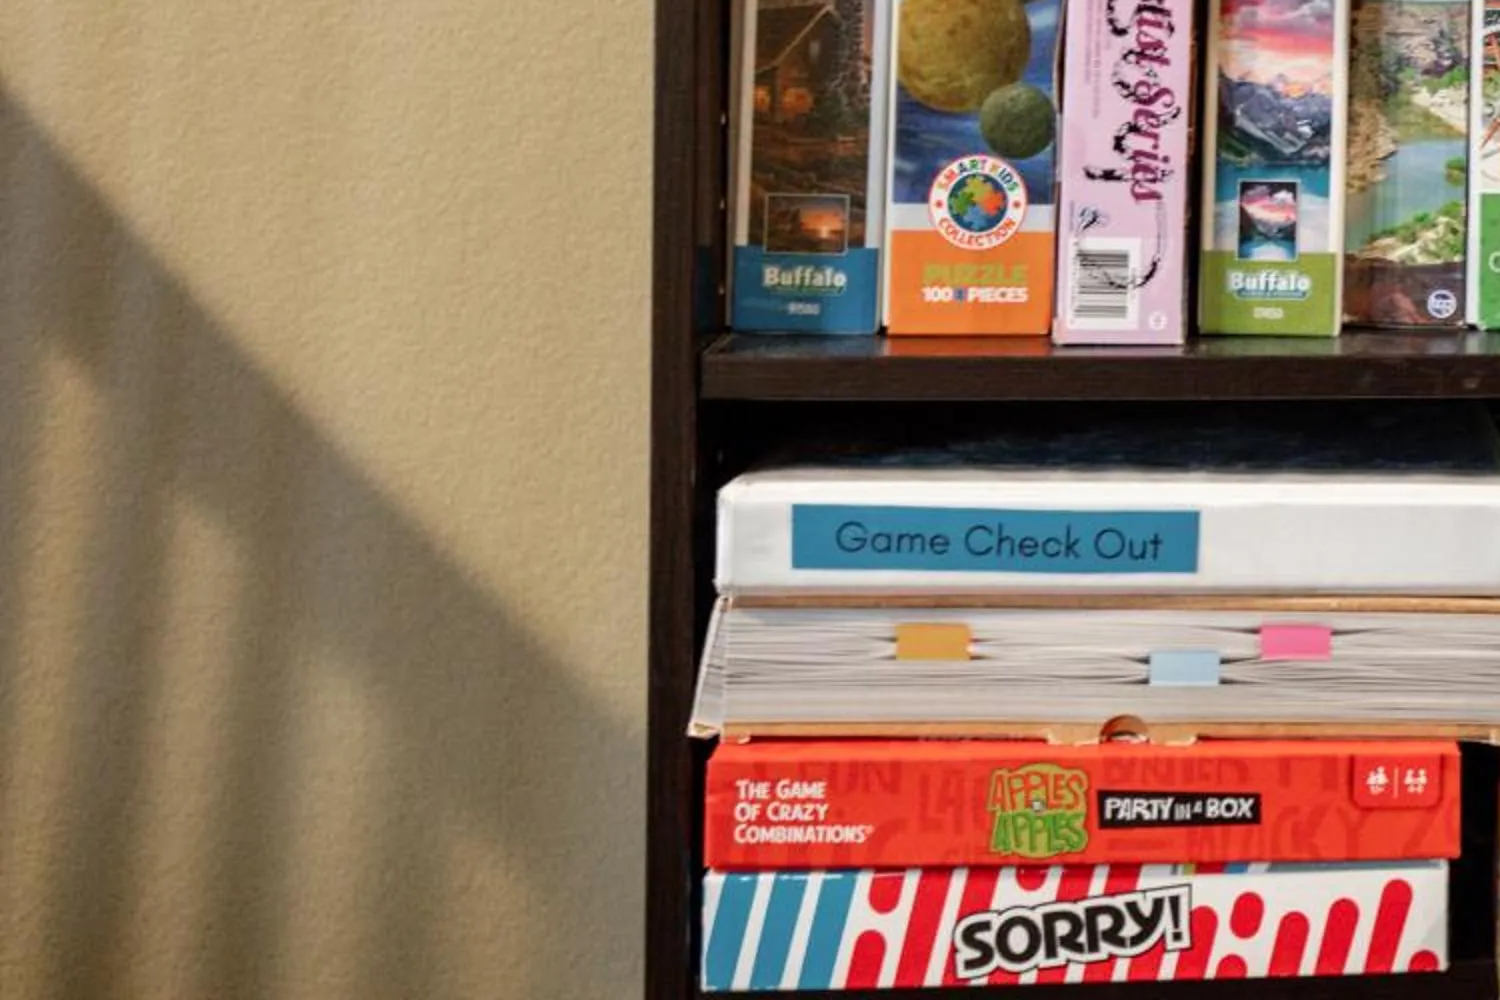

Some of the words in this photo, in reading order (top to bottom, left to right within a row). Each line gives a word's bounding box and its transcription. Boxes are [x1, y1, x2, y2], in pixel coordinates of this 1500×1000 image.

[938, 216, 1017, 247] COLLECTION
[761, 264, 848, 288] Buffalo
[1228, 269, 1311, 291] Buffalo
[968, 287, 1028, 302] PIECES
[835, 520, 950, 555] Game
[963, 522, 1082, 559] Check
[1093, 527, 1164, 560] Out
[736, 779, 771, 800] THE
[776, 779, 828, 800] GAME
[735, 802, 760, 821] OF
[766, 802, 829, 821] CRAZY
[1104, 797, 1174, 821] PARTY
[1175, 803, 1191, 820] IN
[1205, 797, 1254, 819] BOX
[958, 893, 1185, 970] SORRY!
